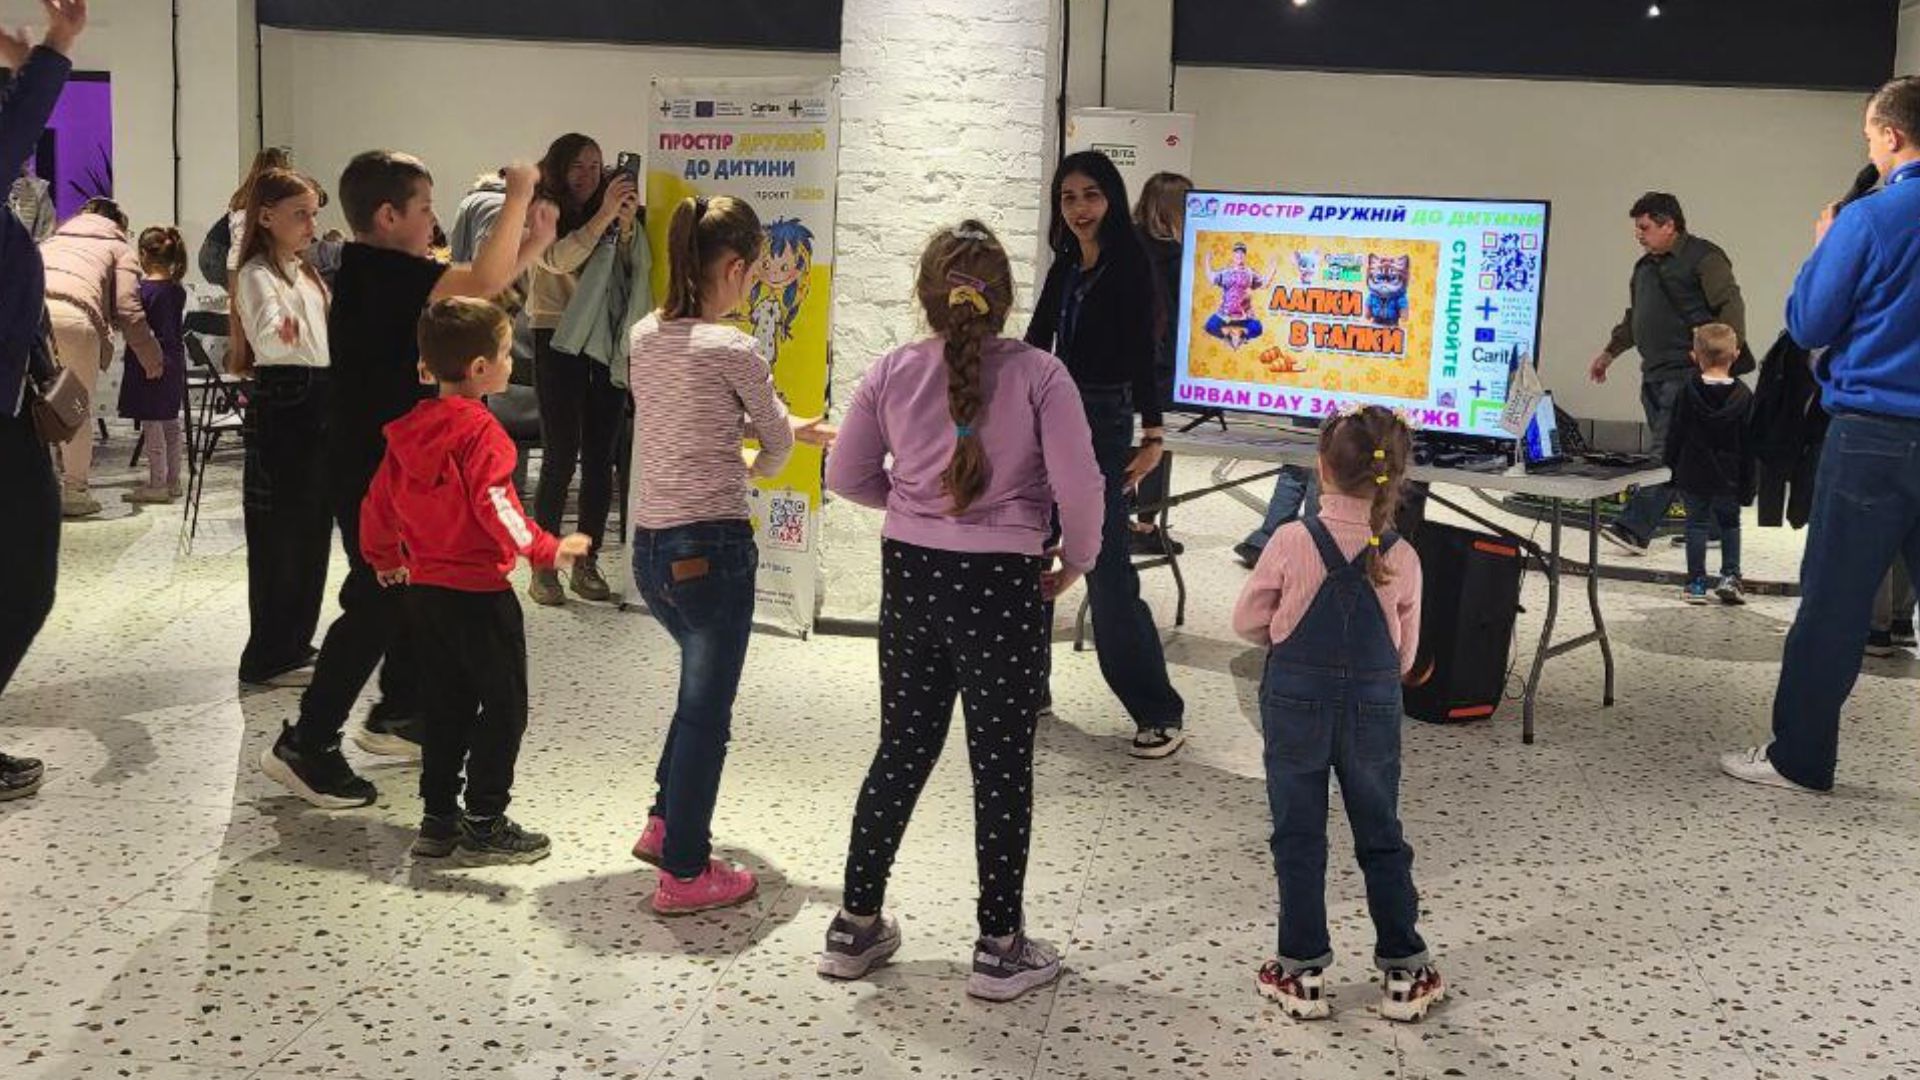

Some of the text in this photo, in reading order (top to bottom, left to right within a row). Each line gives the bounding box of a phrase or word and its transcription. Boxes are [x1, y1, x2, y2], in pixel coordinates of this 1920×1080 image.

[659, 133, 734, 150] ПРОСТІР
[684, 159, 796, 180] ДО ДИТИНИ
[1223, 202, 1305, 218] ПРОСТІР
[1307, 204, 1407, 223] ДРУЖНІЙ
[1411, 210, 1445, 226] ДО
[1269, 286, 1363, 316] ЛАПКИ
[1442, 239, 1466, 378] СТАНЦЮЙТЕ
[1289, 320, 1405, 355] В ТАПКИ
[1471, 346, 1514, 365] Carit
[1178, 383, 1251, 406] URBAN
[1257, 394, 1304, 411] DAY
